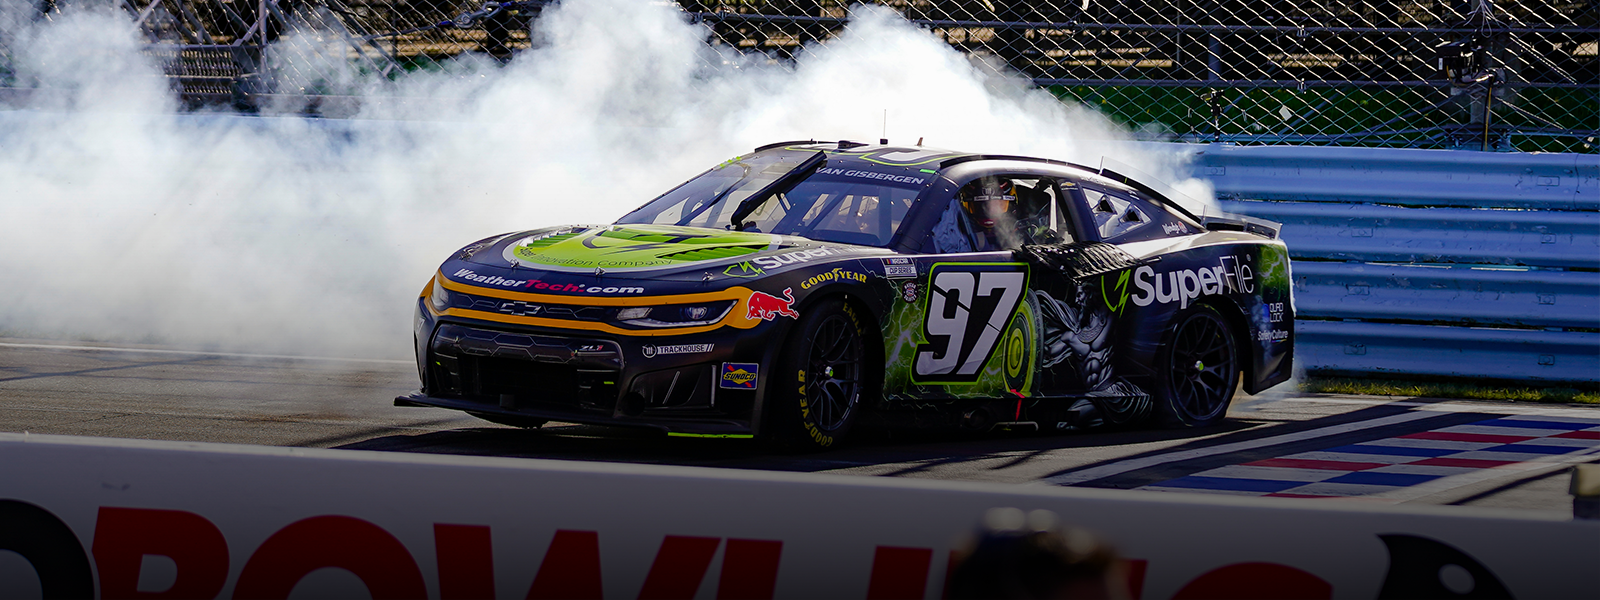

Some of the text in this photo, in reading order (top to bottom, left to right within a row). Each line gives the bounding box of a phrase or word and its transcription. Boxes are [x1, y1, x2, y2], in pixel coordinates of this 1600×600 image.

[815, 167, 925, 185] VAN GISBERGEN
[597, 259, 673, 267] Company
[453, 268, 645, 293] WeatherTech.com
[800, 268, 867, 290] GOODYEAR
[1131, 255, 1254, 310] SuperFile
[1269, 302, 1284, 313] QUAD
[916, 272, 1024, 375] 97
[1269, 312, 1284, 323] LOCK
[660, 345, 705, 353] TRACKHOUSE
[723, 373, 756, 381] SUNOCO
[798, 369, 833, 447] GOODYEAR
